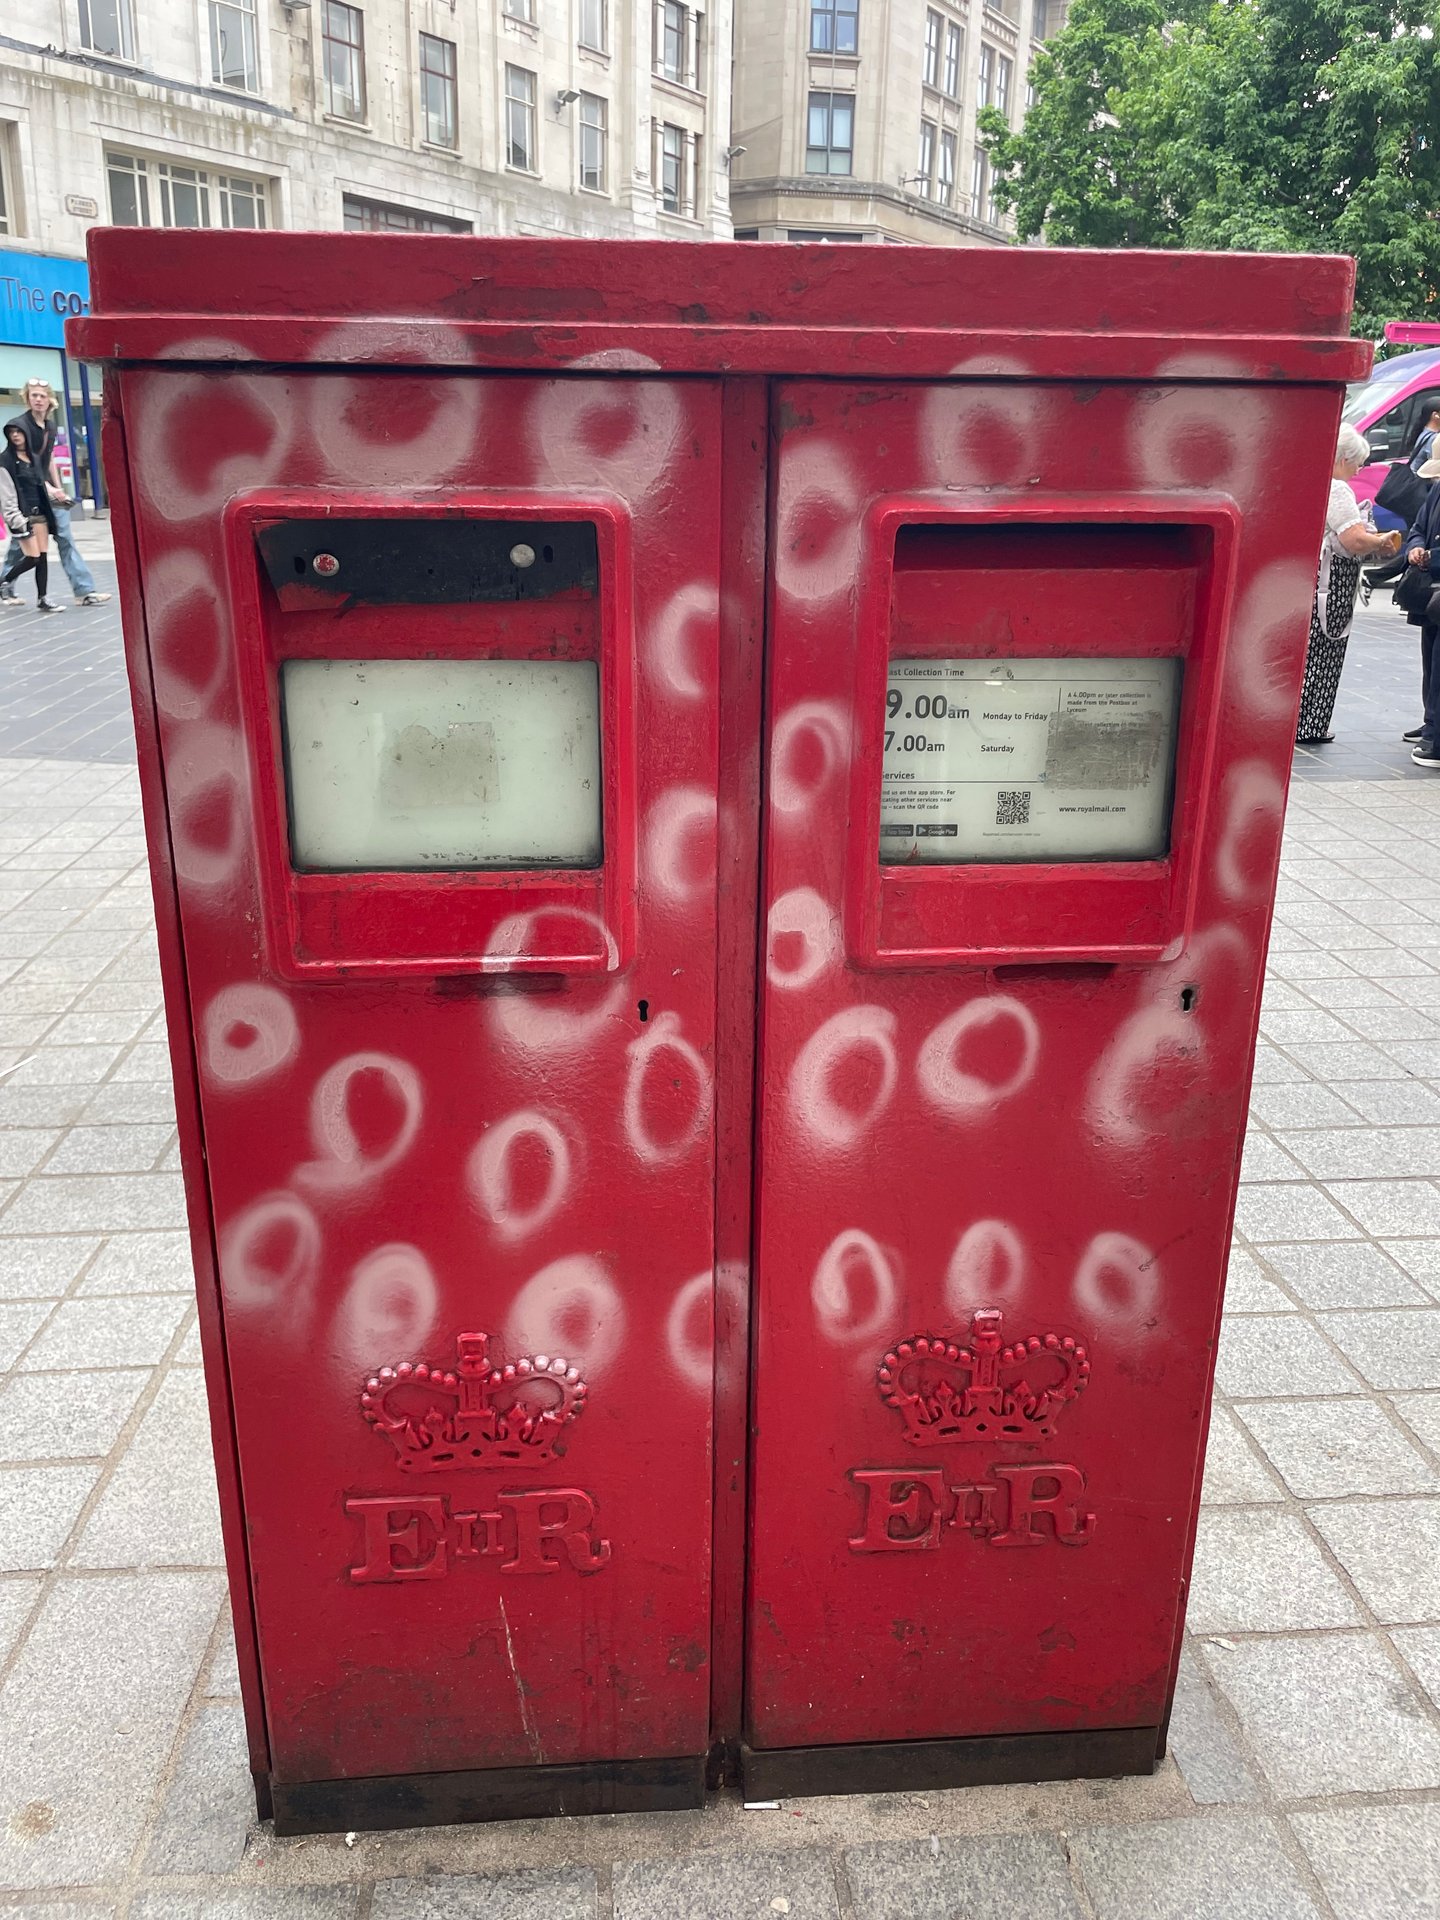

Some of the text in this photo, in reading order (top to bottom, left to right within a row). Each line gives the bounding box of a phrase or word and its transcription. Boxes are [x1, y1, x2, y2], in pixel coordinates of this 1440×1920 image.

[0, 277, 90, 316] The co-
[888, 668, 965, 676] ast Collection Time
[886, 688, 970, 719] 9.00am
[983, 712, 1011, 722] Monday
[1024, 712, 1048, 721] Friday
[884, 730, 1015, 753] 7.00am Saturday
[1059, 805, 1126, 814] www.royalmail.com
